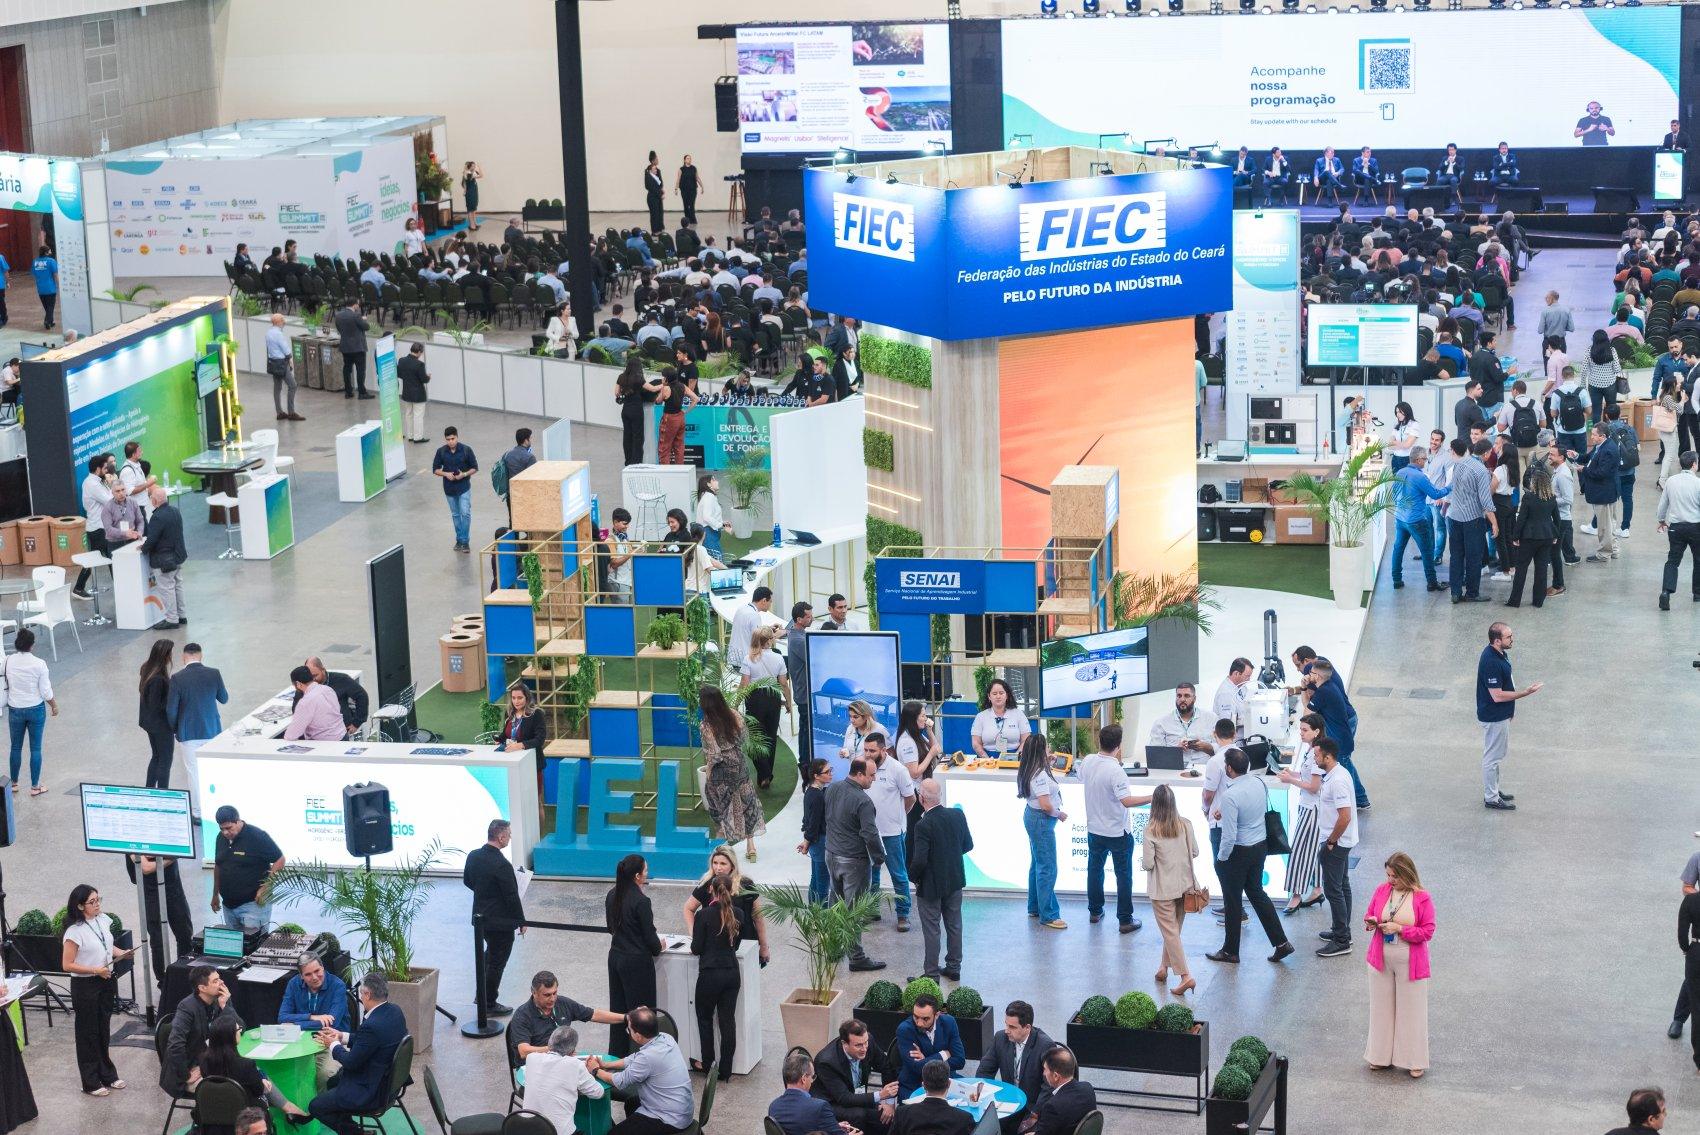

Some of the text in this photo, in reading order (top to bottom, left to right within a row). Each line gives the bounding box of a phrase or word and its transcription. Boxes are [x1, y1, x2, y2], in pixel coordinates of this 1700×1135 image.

[1250, 66, 1327, 78] Acompanhe
[1250, 82, 1288, 91] nossa
[1250, 93, 1336, 107] programação
[843, 202, 905, 251] FIEC
[1036, 200, 1151, 251] FIEC
[957, 266, 1021, 283] Federação
[1024, 263, 1046, 277] das
[1049, 257, 1109, 274] Indústrias
[1112, 255, 1127, 268] do
[1130, 251, 1170, 266] Estado
[1173, 249, 1188, 261] do
[1192, 244, 1225, 259] Ceará
[1003, 274, 1183, 303] PELO FUTURO DA INDÚSTRIA
[719, 424, 759, 433] ENTREGA
[716, 433, 770, 445] DEVOLUÇÃO
[723, 443, 735, 452] DE
[904, 573, 956, 586] SENAI
[554, 758, 711, 848] IEL
